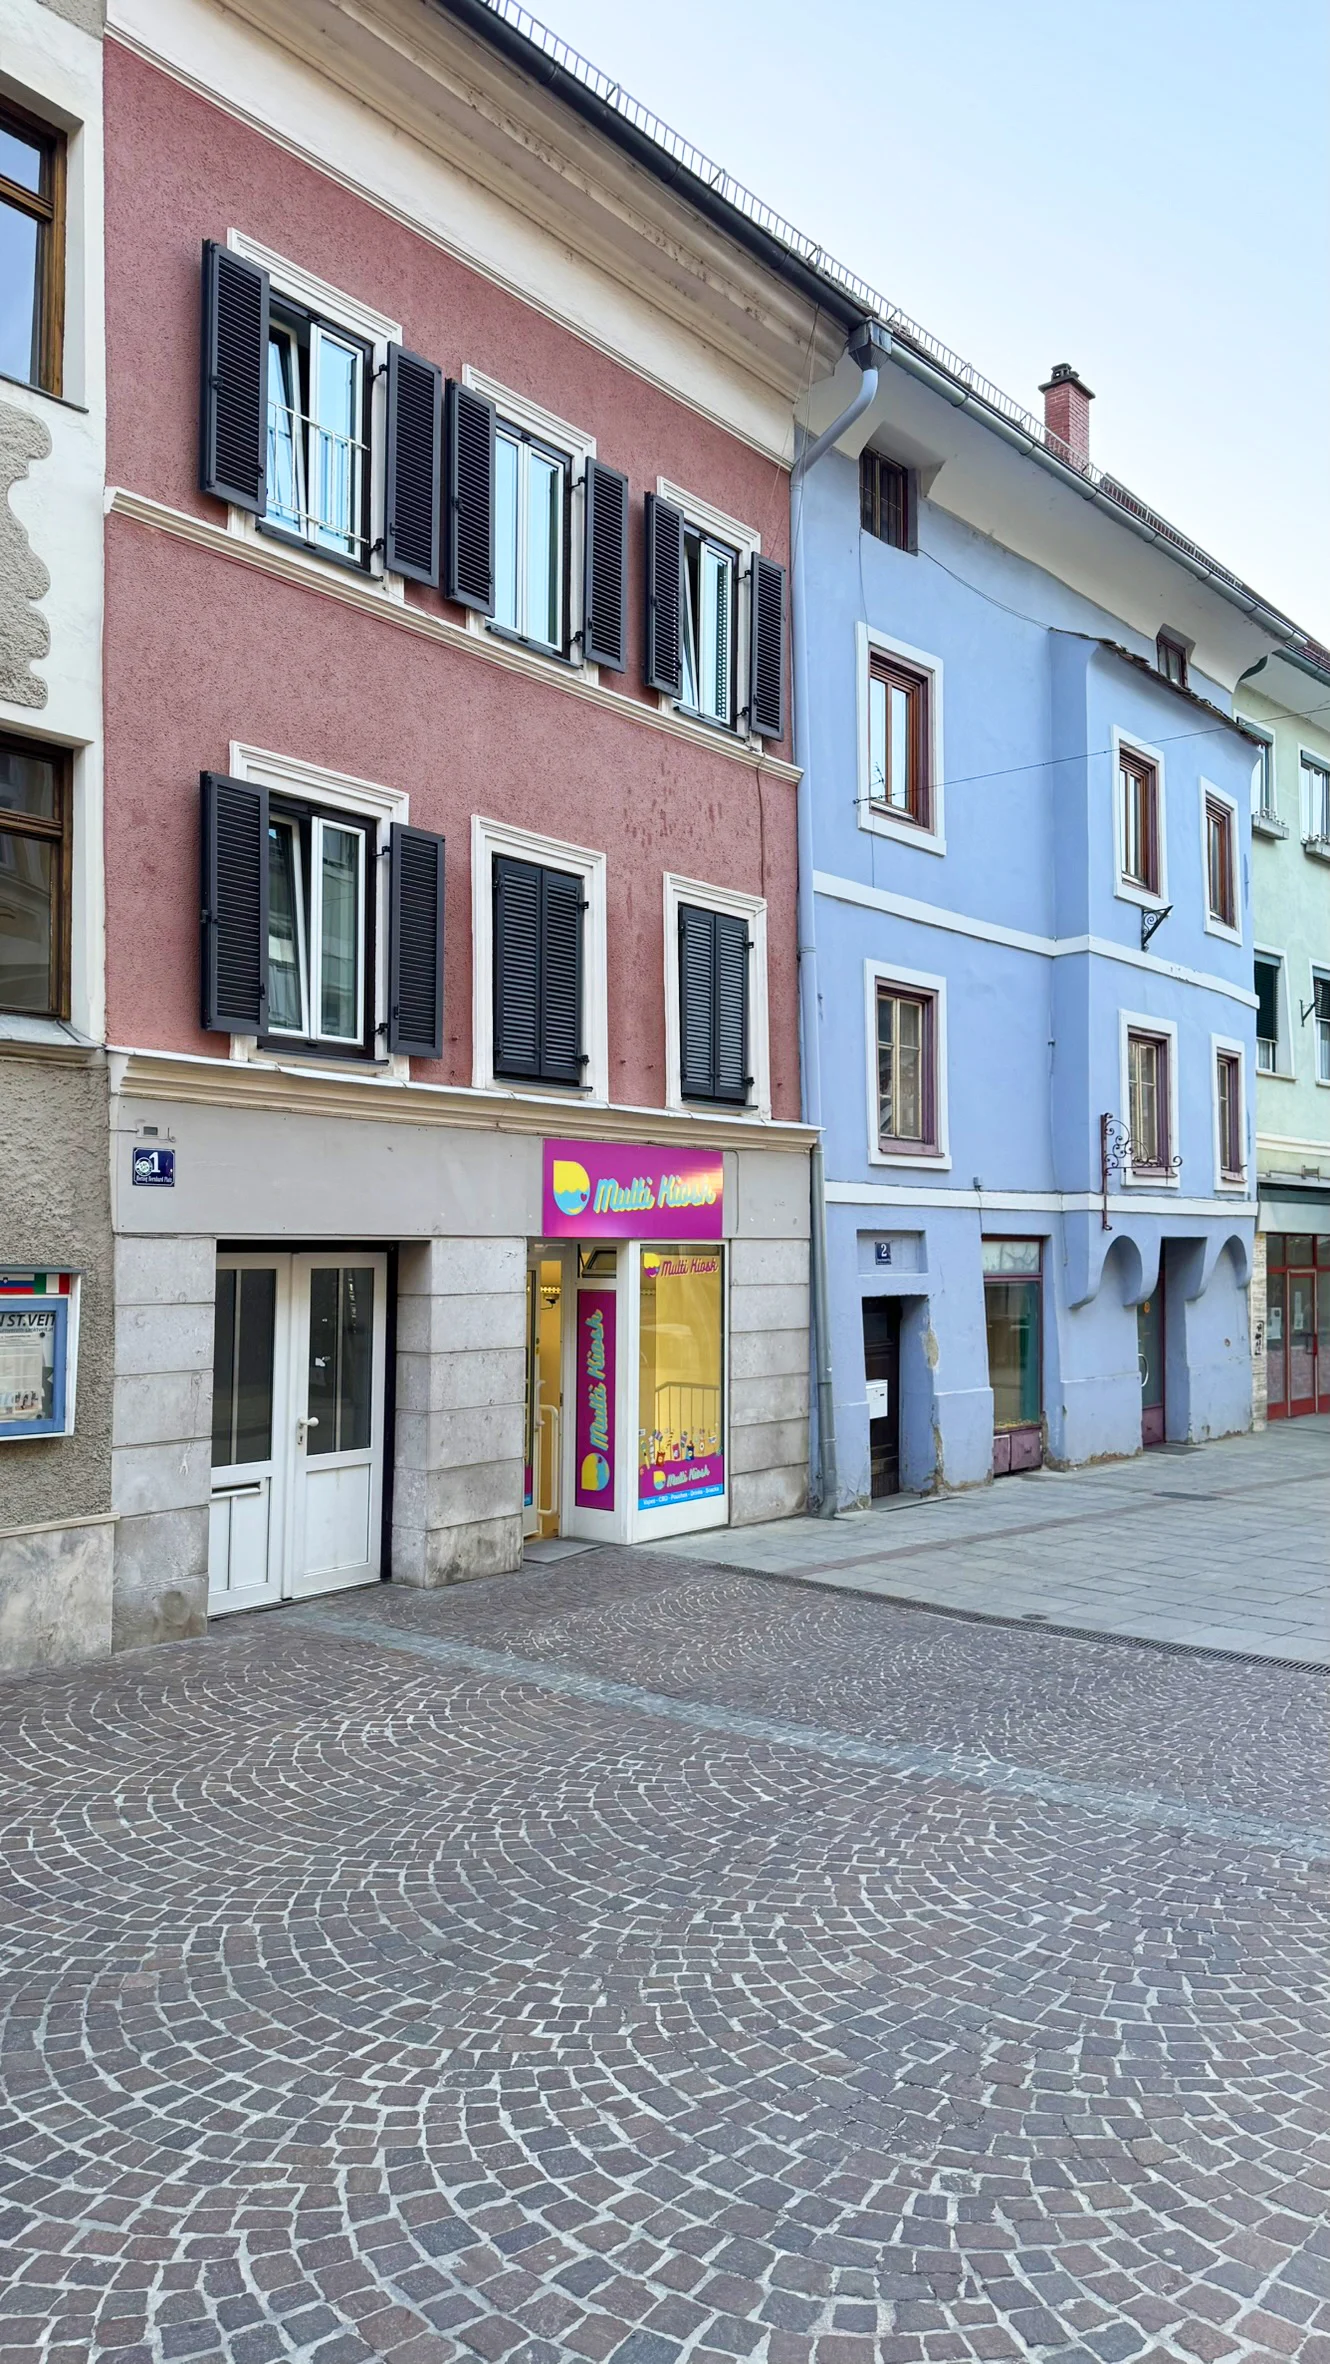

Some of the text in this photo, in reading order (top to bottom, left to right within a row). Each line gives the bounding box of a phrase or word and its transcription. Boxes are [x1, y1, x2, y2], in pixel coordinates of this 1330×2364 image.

[149, 1151, 161, 1172] 1
[593, 1174, 717, 1214] Multi Kiosk
[881, 1243, 888, 1257] 2
[661, 1257, 718, 1277] Multi Kiosk
[585, 1309, 609, 1451] Multi Kiosk
[666, 1464, 710, 1488] Multi Kiosk
